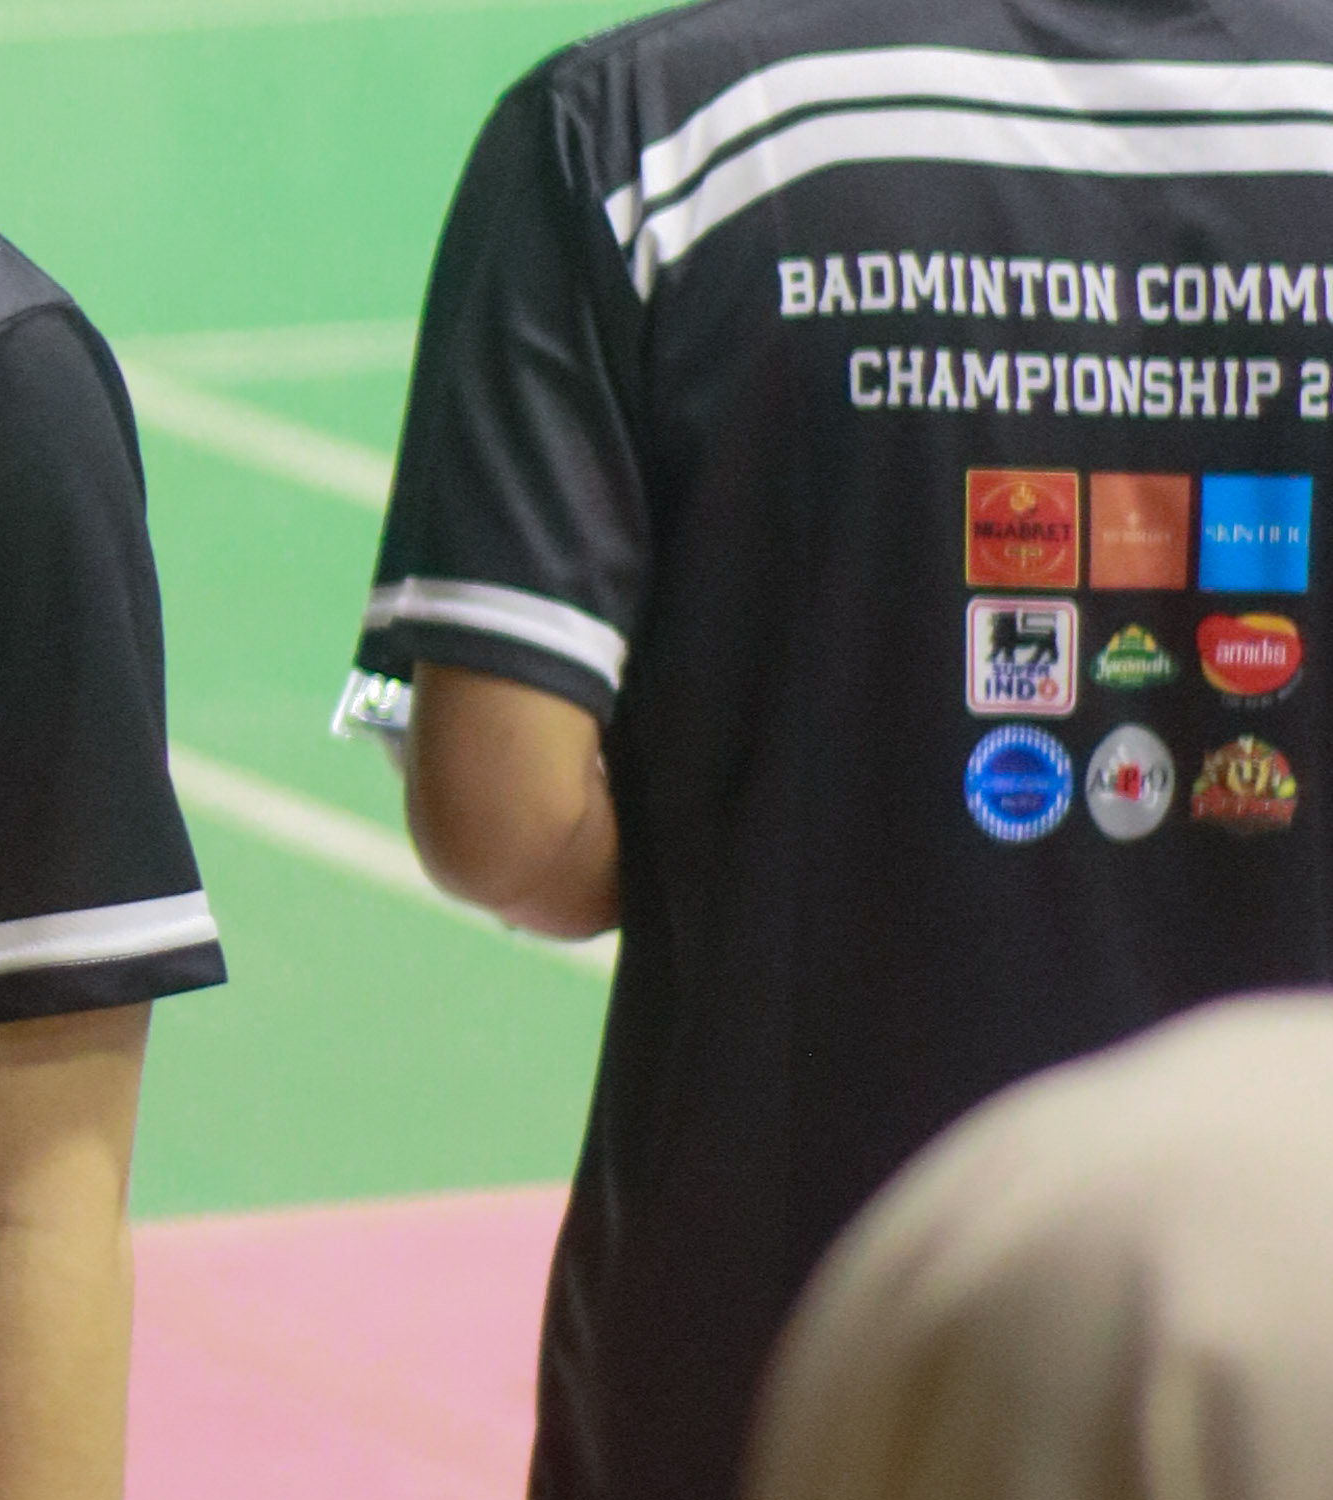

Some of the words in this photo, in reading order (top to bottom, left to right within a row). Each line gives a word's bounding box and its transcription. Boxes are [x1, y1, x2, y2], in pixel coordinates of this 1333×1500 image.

[778, 252, 1118, 323] BADMINTON
[1137, 264, 1333, 325] COMM
[849, 348, 1281, 418] CHAMPIONSHIP
